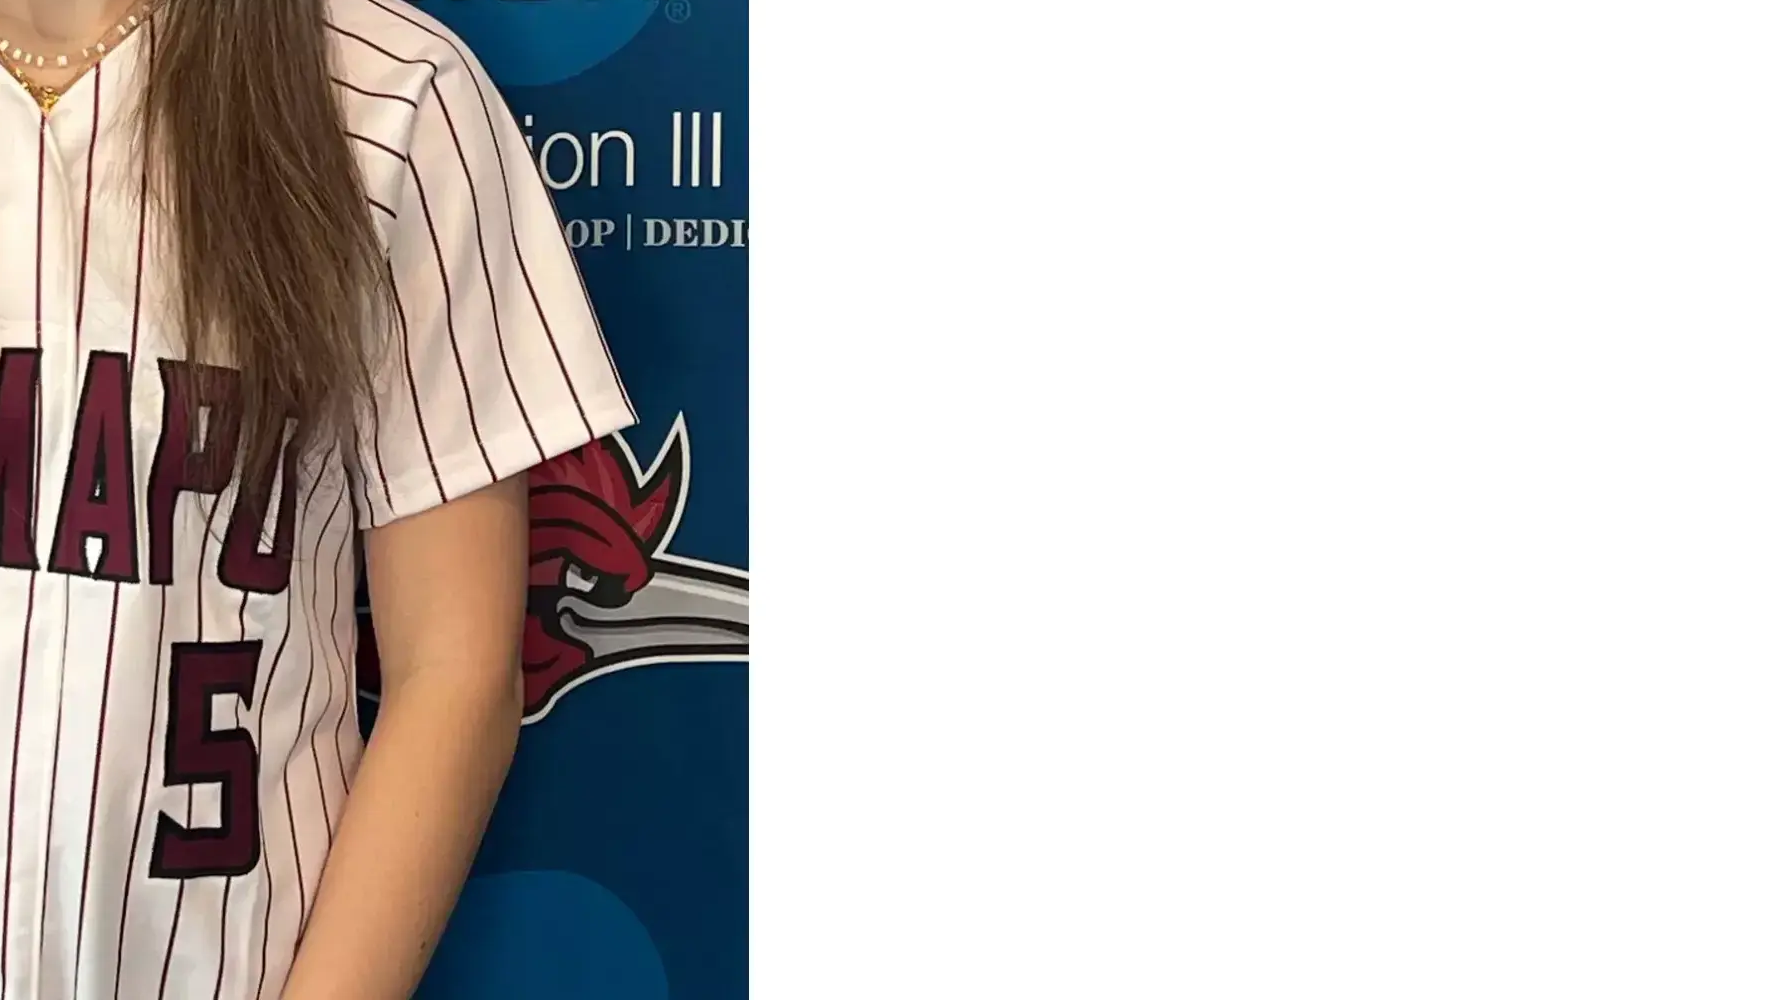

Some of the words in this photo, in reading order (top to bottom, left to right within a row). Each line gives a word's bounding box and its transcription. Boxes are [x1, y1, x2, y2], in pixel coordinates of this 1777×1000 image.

[672, 111, 723, 188] III
[642, 218, 749, 248] DEDI
[149, 638, 266, 880] 5
